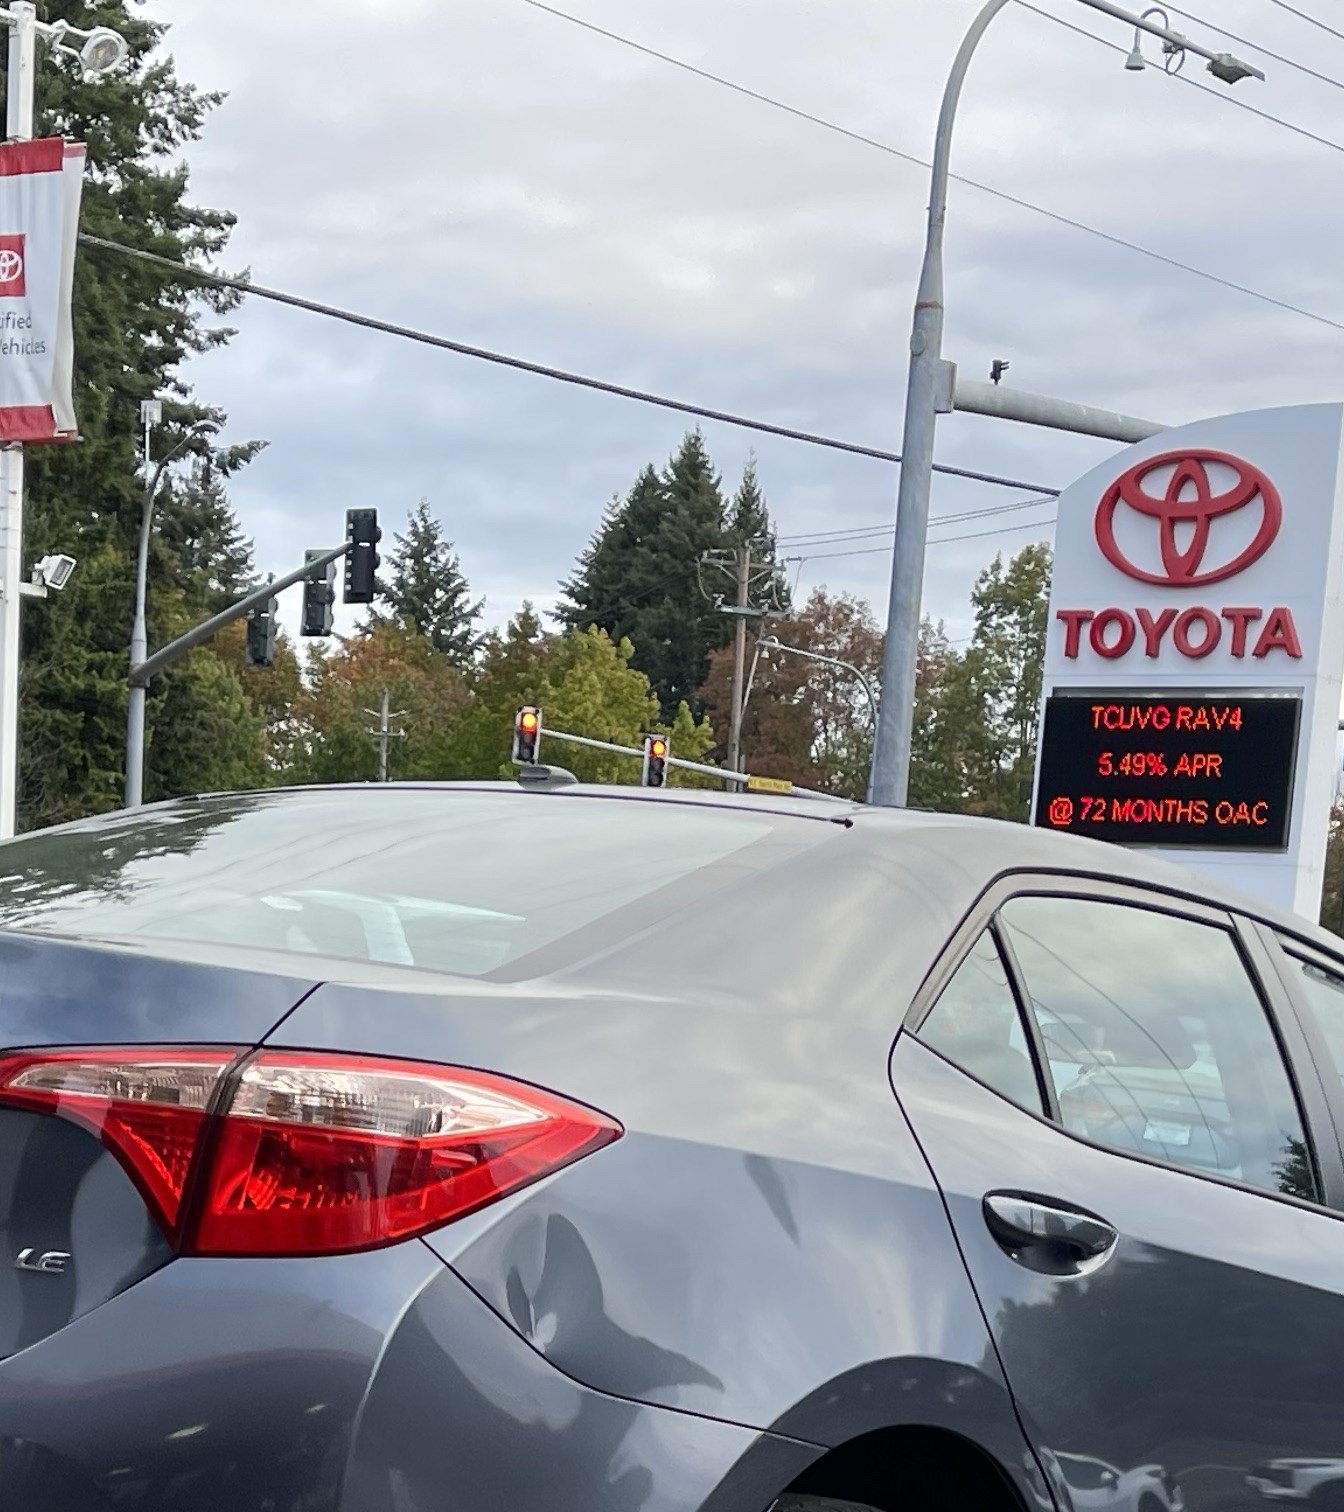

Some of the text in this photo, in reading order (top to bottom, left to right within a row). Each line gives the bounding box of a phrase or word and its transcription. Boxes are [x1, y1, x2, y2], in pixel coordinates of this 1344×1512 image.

[1056, 606, 1303, 659] TOYOTA
[1175, 706, 1244, 732] RAV4
[1098, 752, 1224, 778] 5.49% APR
[1047, 796, 1269, 826] @ 72 MONTHS OAC
[15, 1247, 72, 1274] LE
